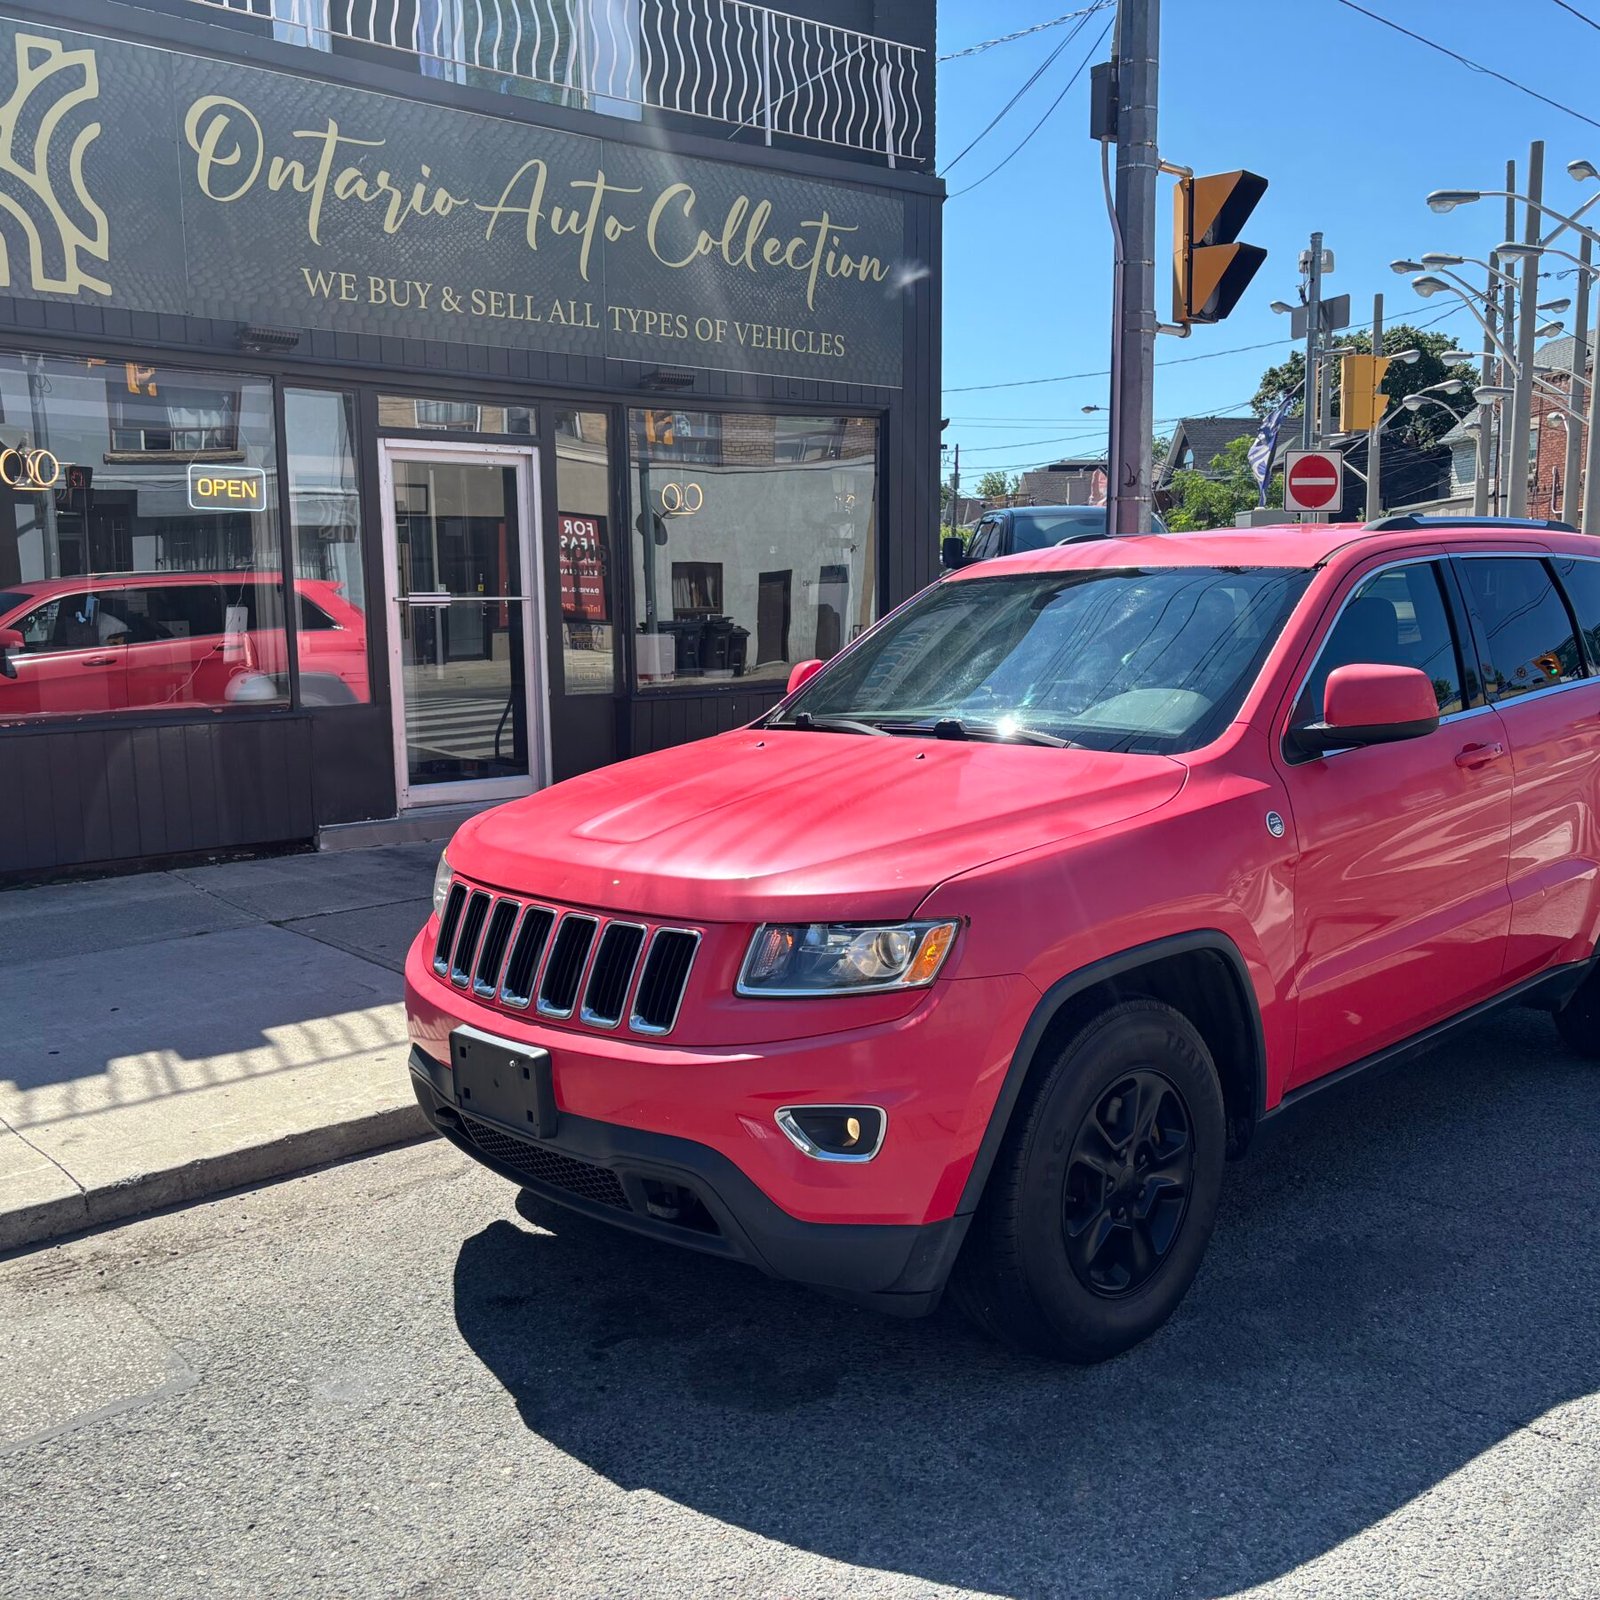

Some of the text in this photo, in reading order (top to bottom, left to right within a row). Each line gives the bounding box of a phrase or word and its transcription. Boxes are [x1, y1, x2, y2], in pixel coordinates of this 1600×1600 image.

[184, 95, 890, 312] Ontario Auto Collection
[300, 267, 846, 358] WE BUY & SELL ALL TYPES OF VEHICLES
[197, 478, 257, 498] OPEN
